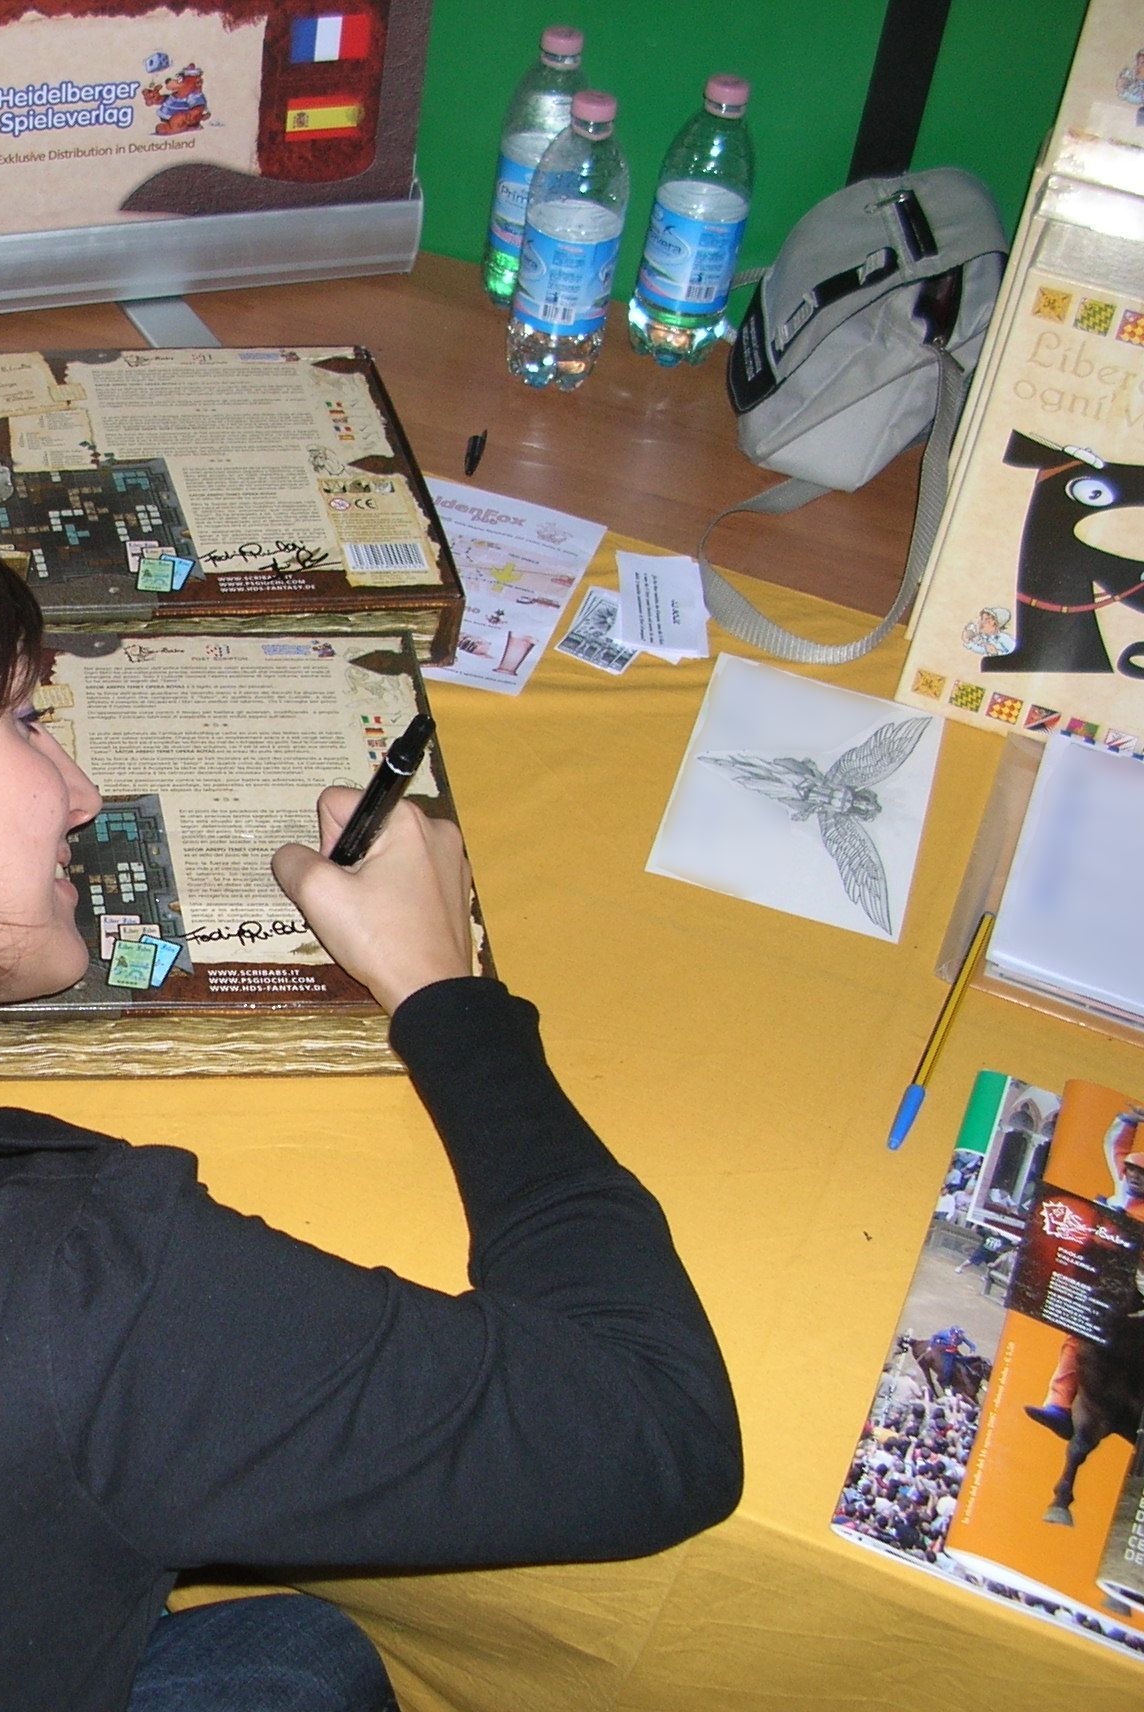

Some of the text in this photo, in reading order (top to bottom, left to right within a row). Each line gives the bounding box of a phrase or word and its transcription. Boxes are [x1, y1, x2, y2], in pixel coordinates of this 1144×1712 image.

[0, 105, 132, 136] Spieleverlag
[48, 147, 112, 161] Distribution
[115, 144, 125, 154] in
[128, 138, 196, 153] Deutschland
[209, 984, 327, 992] WWW.HDS-FANTASY.DE
